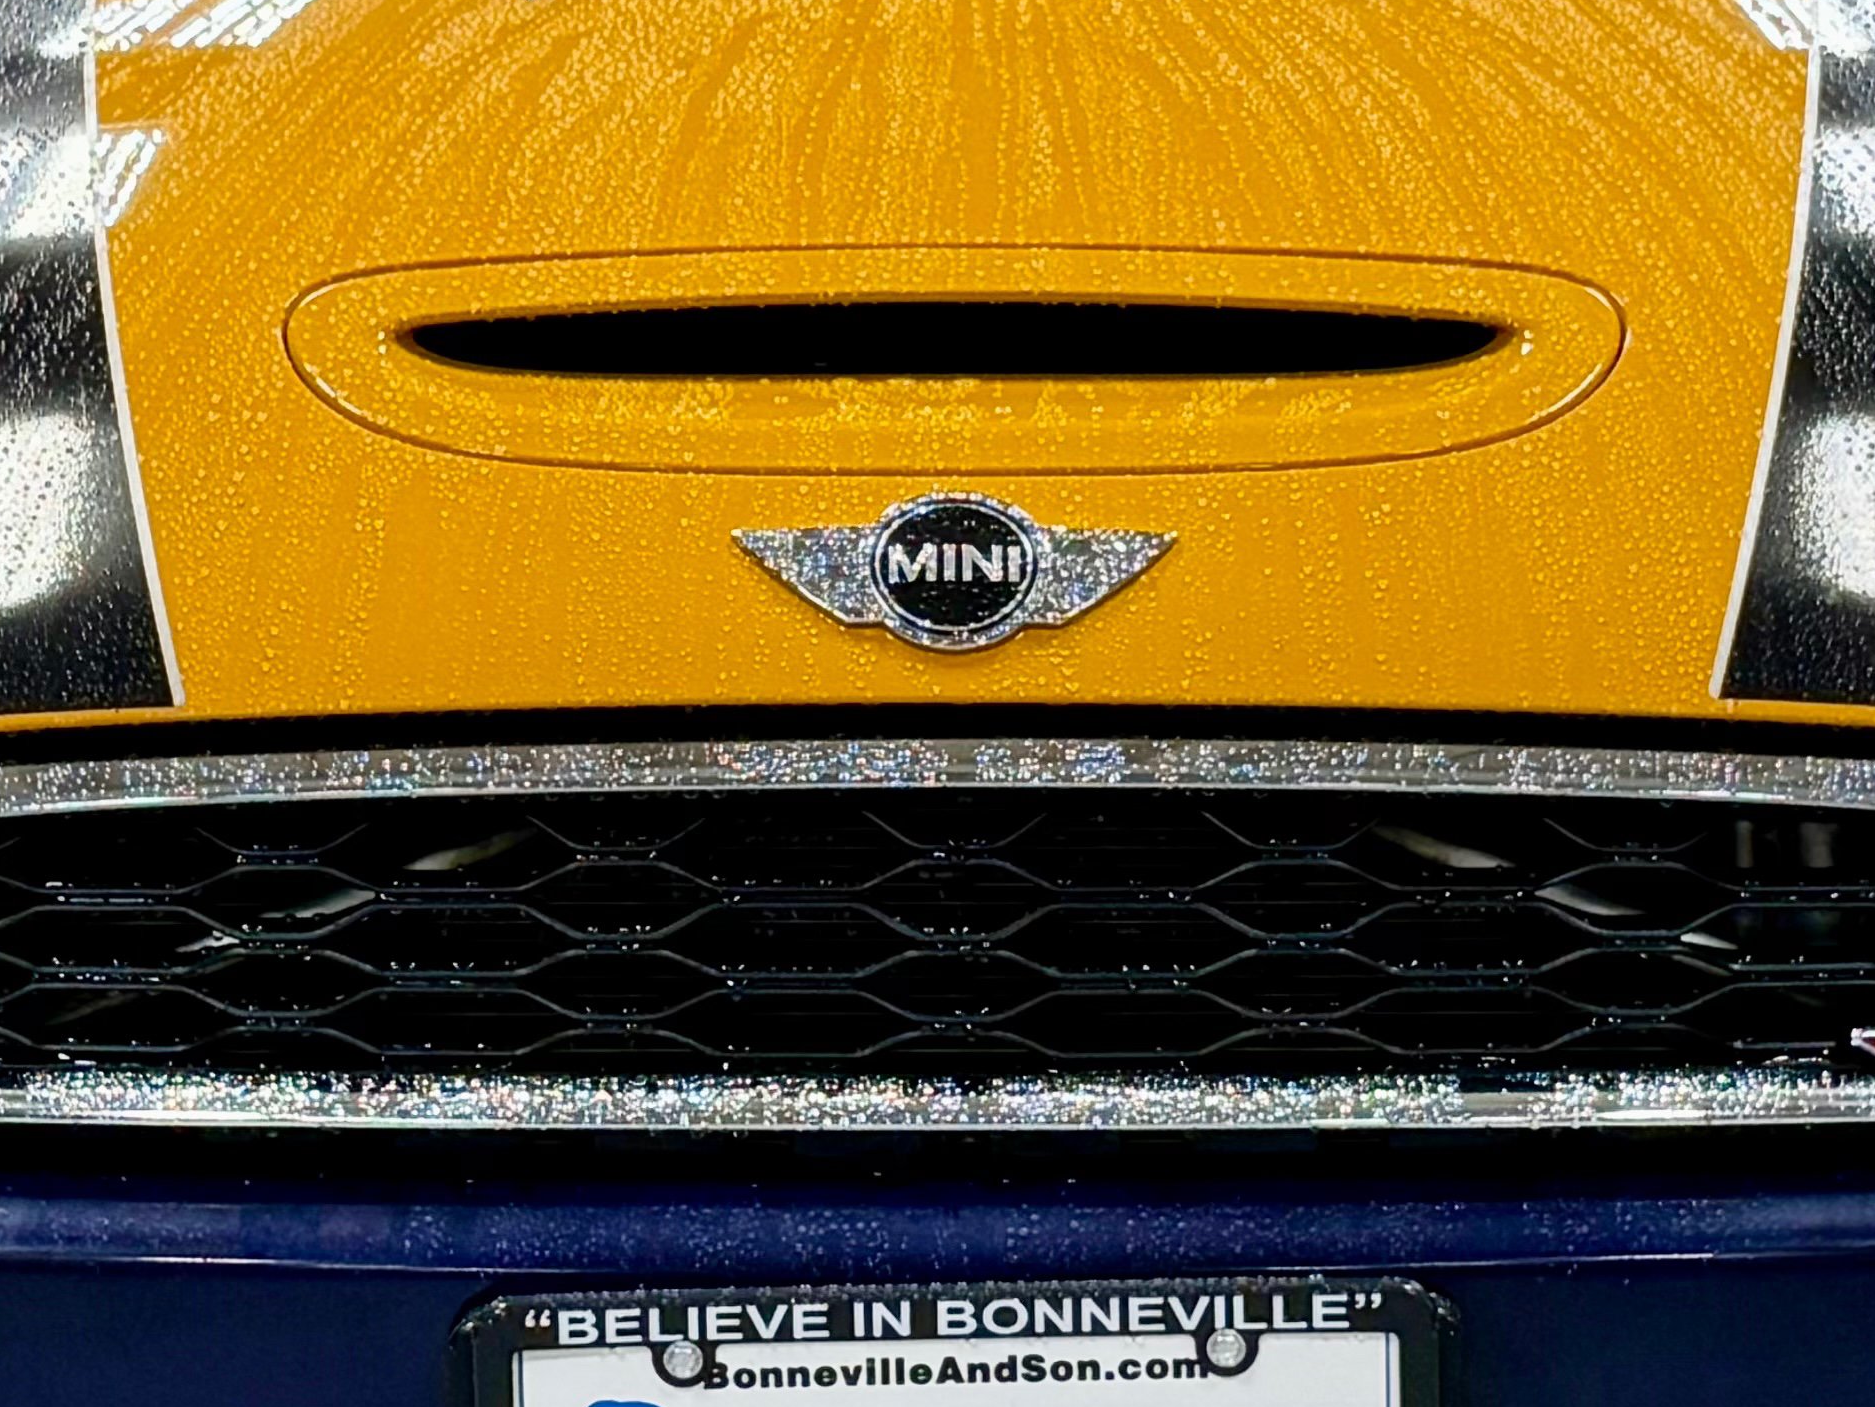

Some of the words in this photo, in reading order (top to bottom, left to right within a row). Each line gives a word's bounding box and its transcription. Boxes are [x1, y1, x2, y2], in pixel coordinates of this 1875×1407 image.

[887, 543, 1022, 584] MINI
[853, 1300, 912, 1339] IN
[703, 1353, 1209, 1390] BonnevilleAndSon.com
